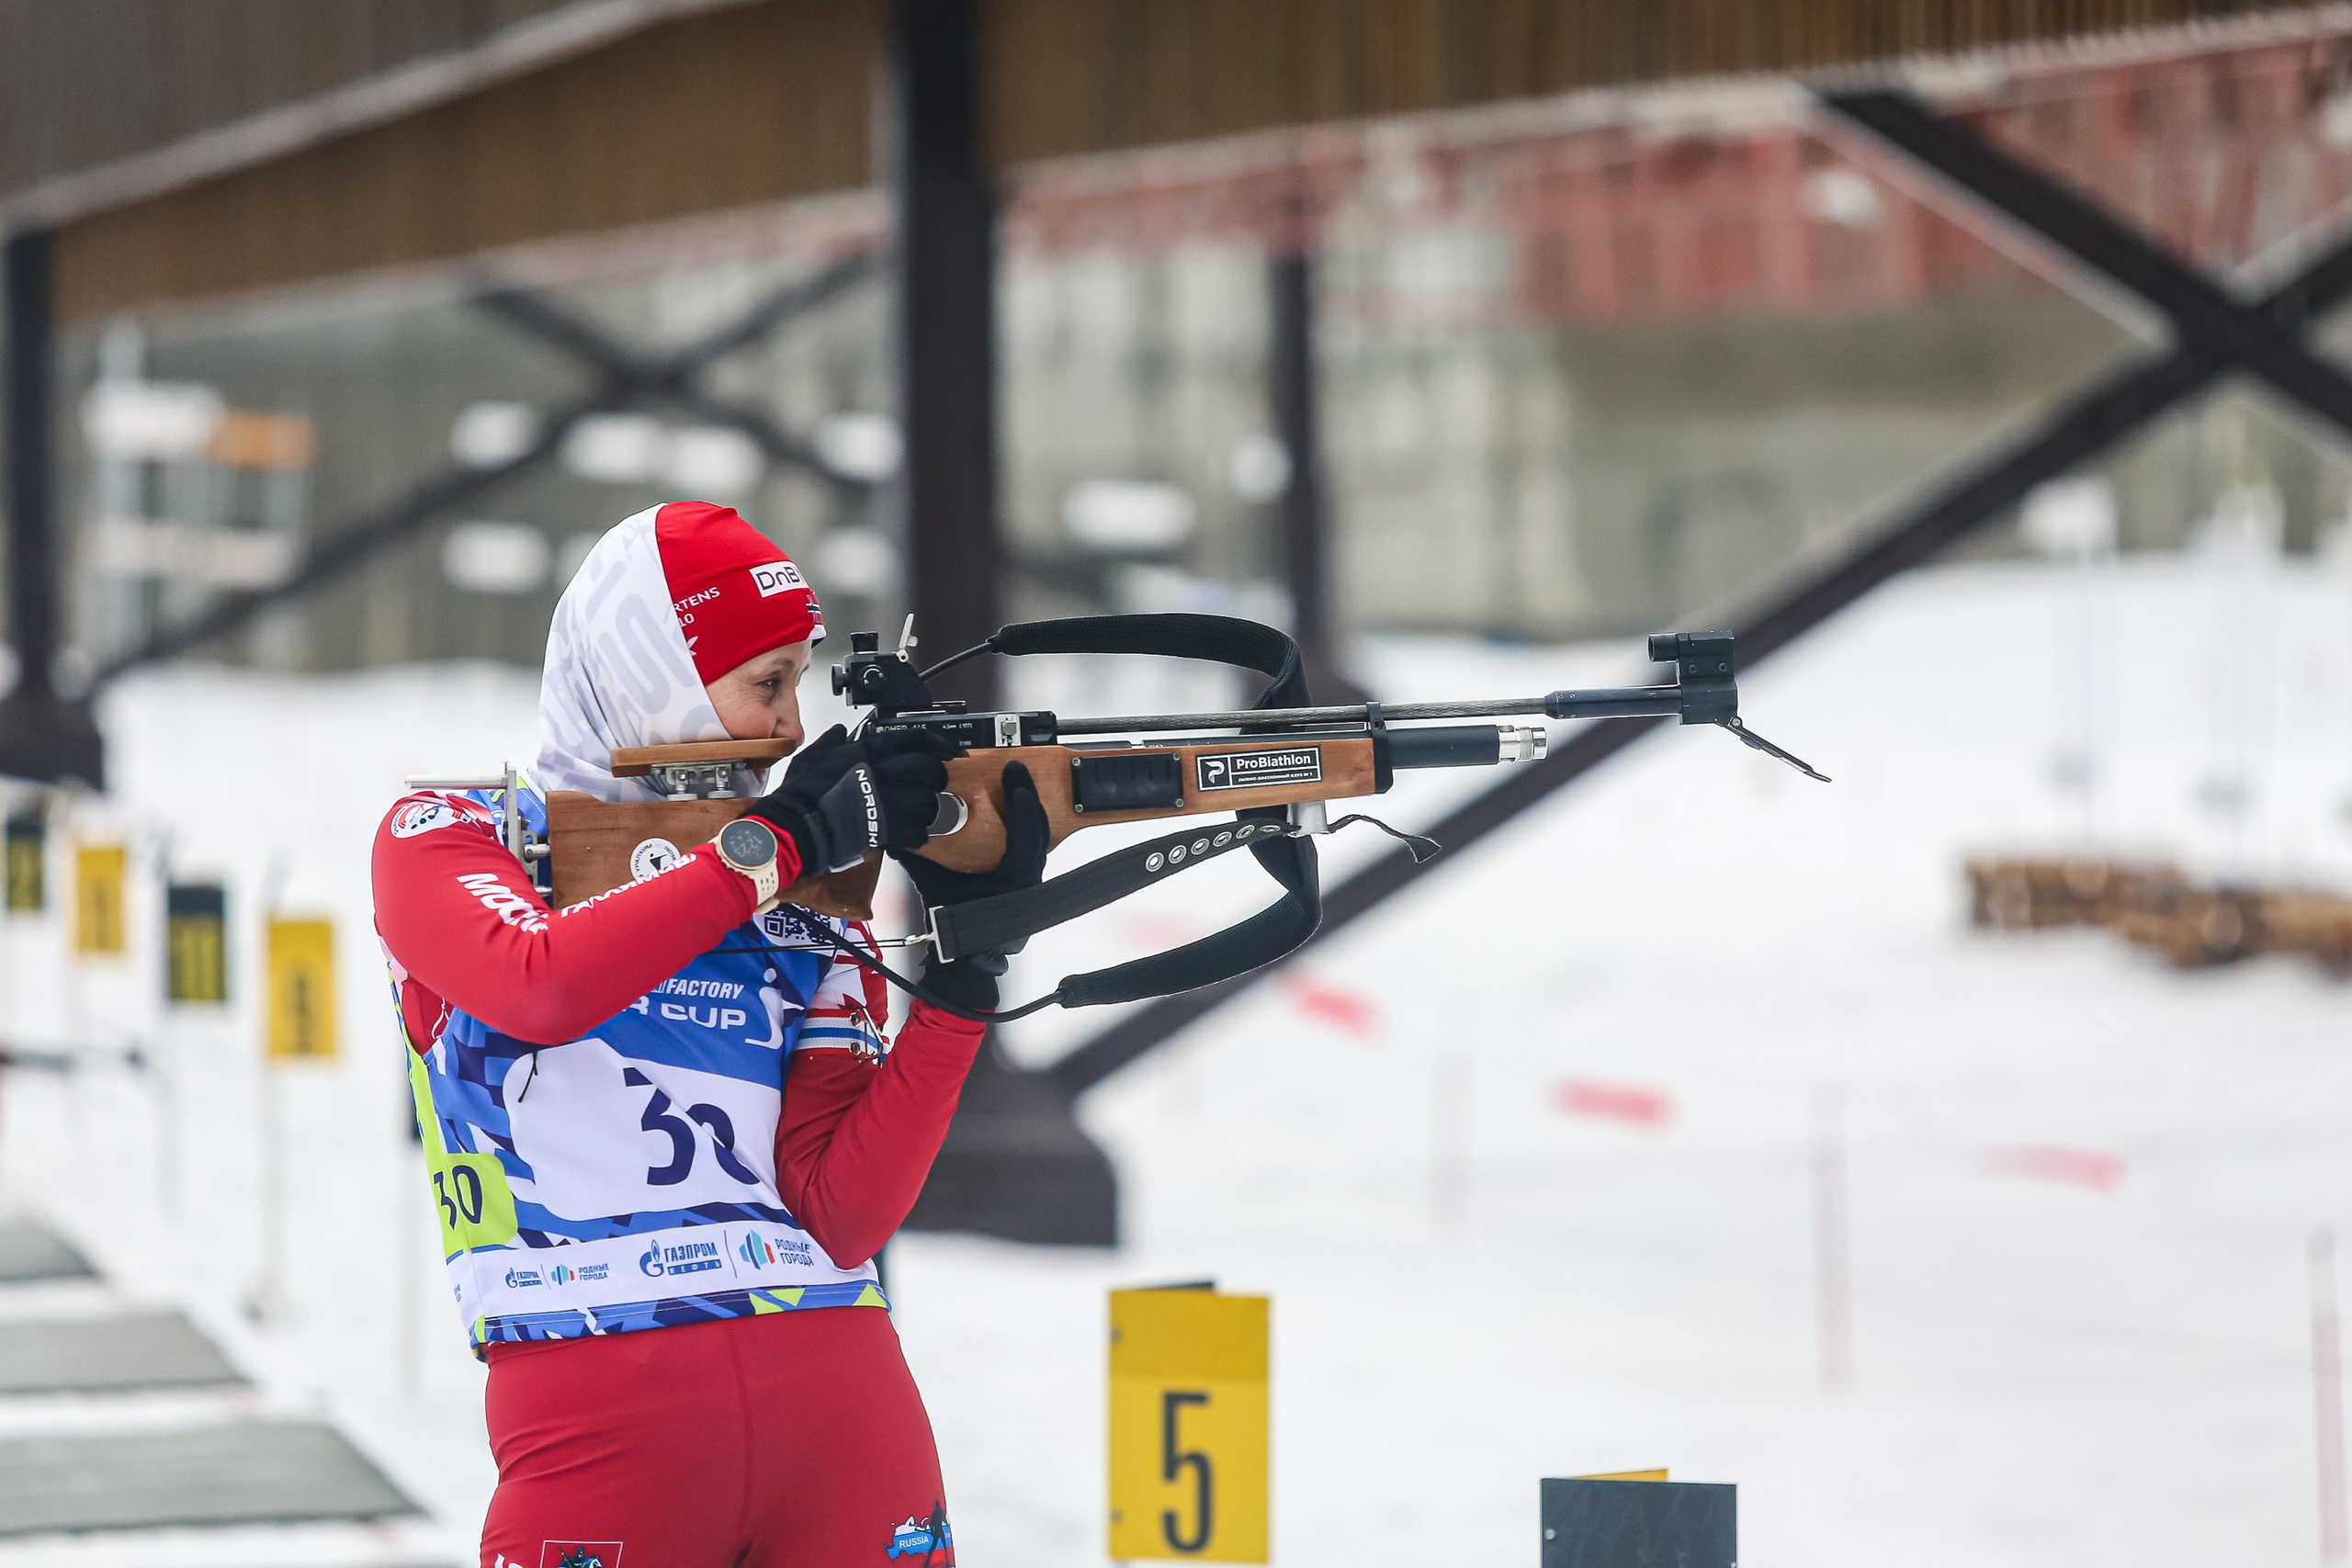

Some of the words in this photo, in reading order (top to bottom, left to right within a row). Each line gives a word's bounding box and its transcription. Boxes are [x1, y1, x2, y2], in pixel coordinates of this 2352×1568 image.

[755, 566, 800, 591] DnB
[1236, 754, 1311, 770] ProBiathlon
[855, 769, 878, 847] NORDSKI
[665, 978, 744, 1000] FACTORY
[661, 1002, 747, 1030] CUP
[434, 1165, 483, 1231] 30
[664, 1242, 718, 1263] ГАЗПРОМ
[775, 1238, 810, 1255] РОДНЫЕ
[578, 1263, 610, 1274] РОДНЫЕ
[669, 1260, 721, 1275] НЕФТЬ
[779, 1252, 815, 1268] ГОРОДА
[579, 1271, 608, 1281] ГОРОДА
[1160, 1389, 1215, 1555] 5
[899, 1536, 930, 1549] RUSSIA
